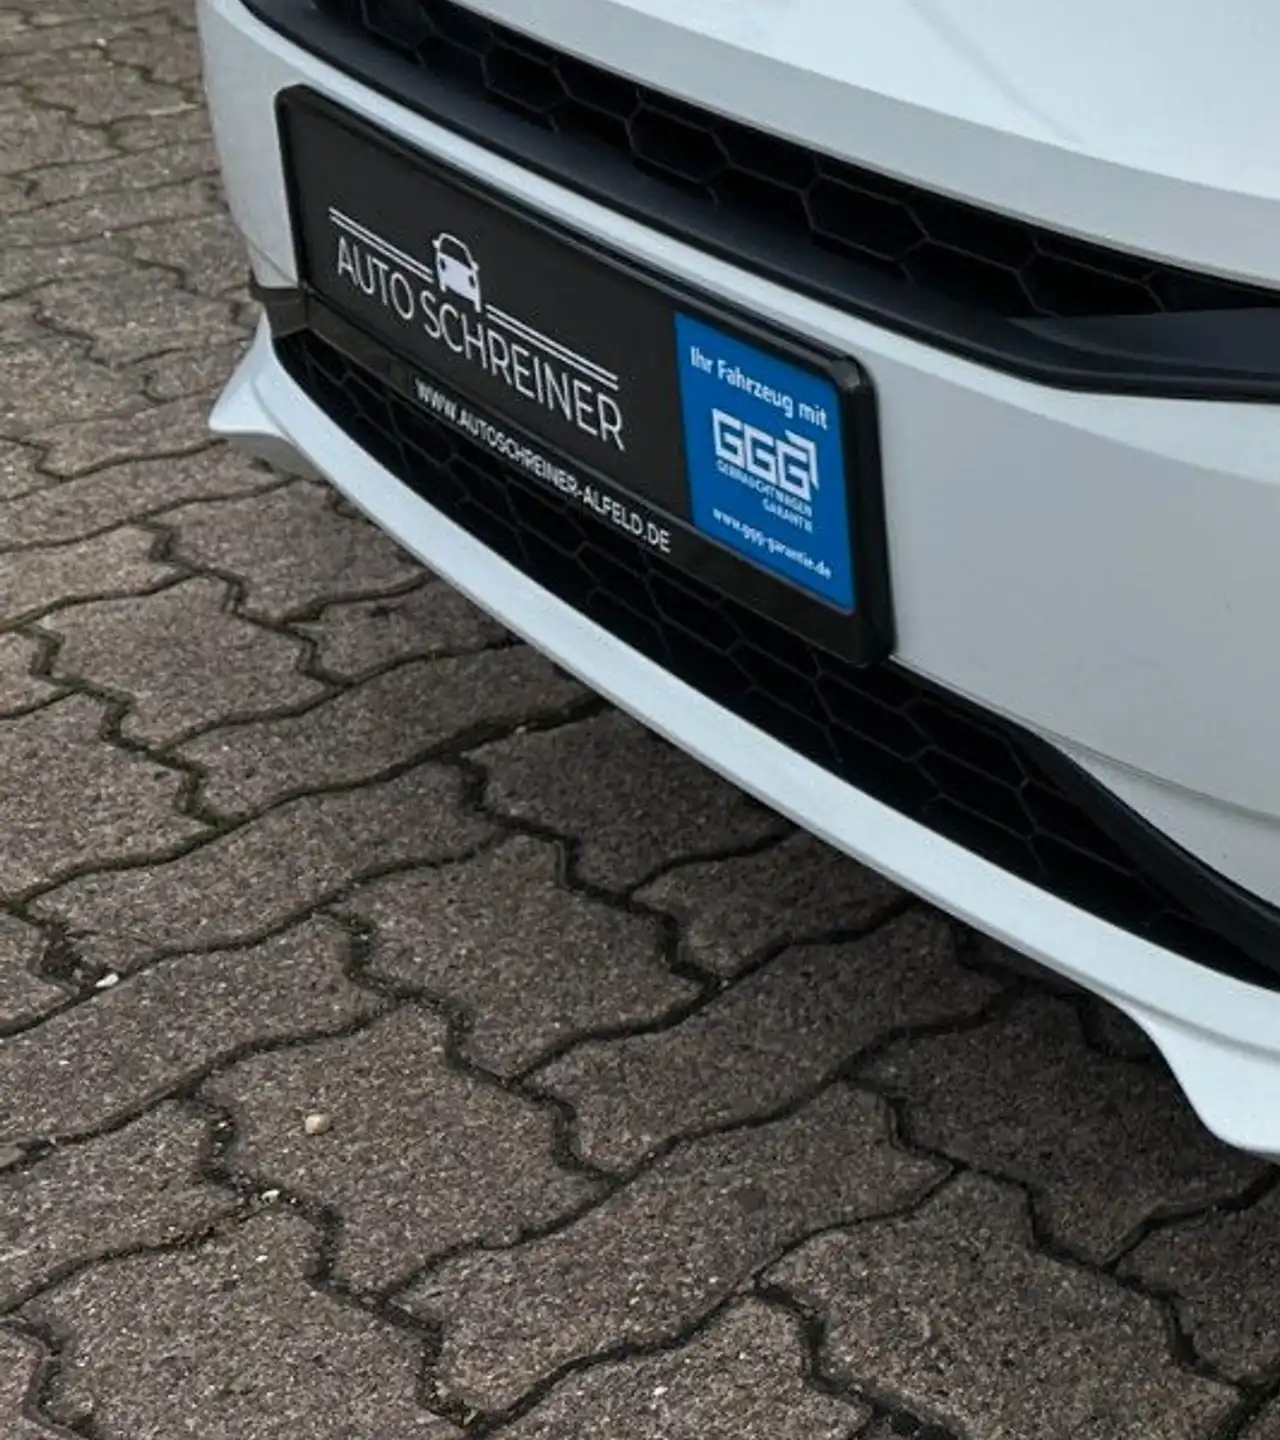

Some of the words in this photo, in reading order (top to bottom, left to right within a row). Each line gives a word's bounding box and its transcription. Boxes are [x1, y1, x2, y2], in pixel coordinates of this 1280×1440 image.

[337, 235, 415, 321] AUTO
[419, 290, 626, 453] SCHREINER
[690, 345, 713, 375] Ihr
[716, 358, 795, 420] Fahrzeug
[798, 402, 830, 431] mit
[414, 377, 673, 554] WWW.AUTOSCHREINER-ALFELD.DE
